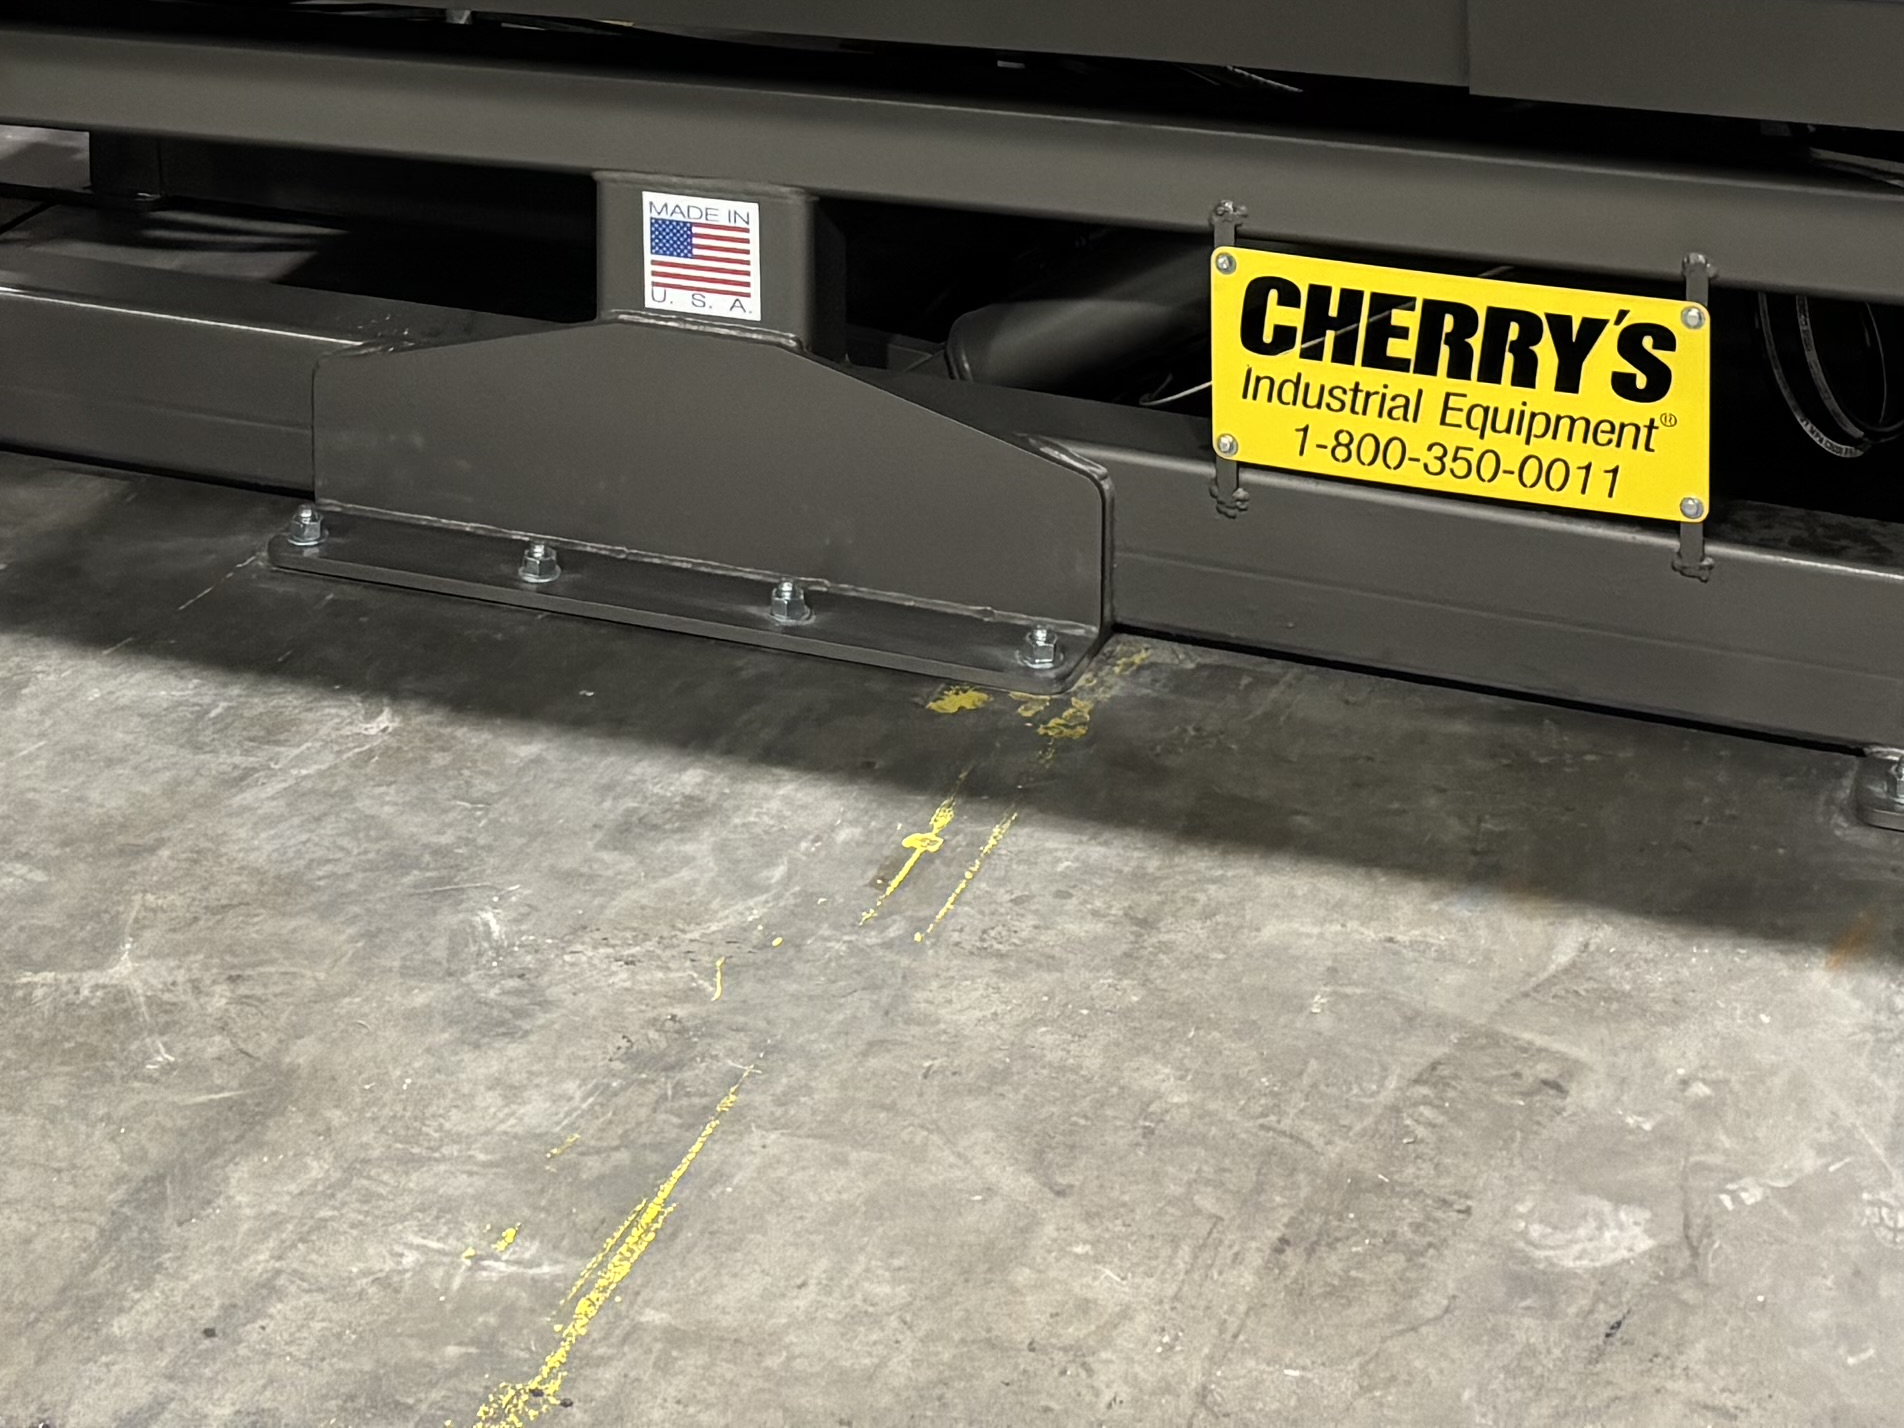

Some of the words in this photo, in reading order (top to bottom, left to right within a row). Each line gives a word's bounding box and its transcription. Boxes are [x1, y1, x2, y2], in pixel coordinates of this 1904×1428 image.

[649, 201, 720, 222] MADE
[727, 208, 750, 226] IN
[1239, 275, 1677, 404] CHERRY'S
[1241, 364, 1424, 425] Industrial
[1294, 424, 1622, 500] 1-800-350-0011
